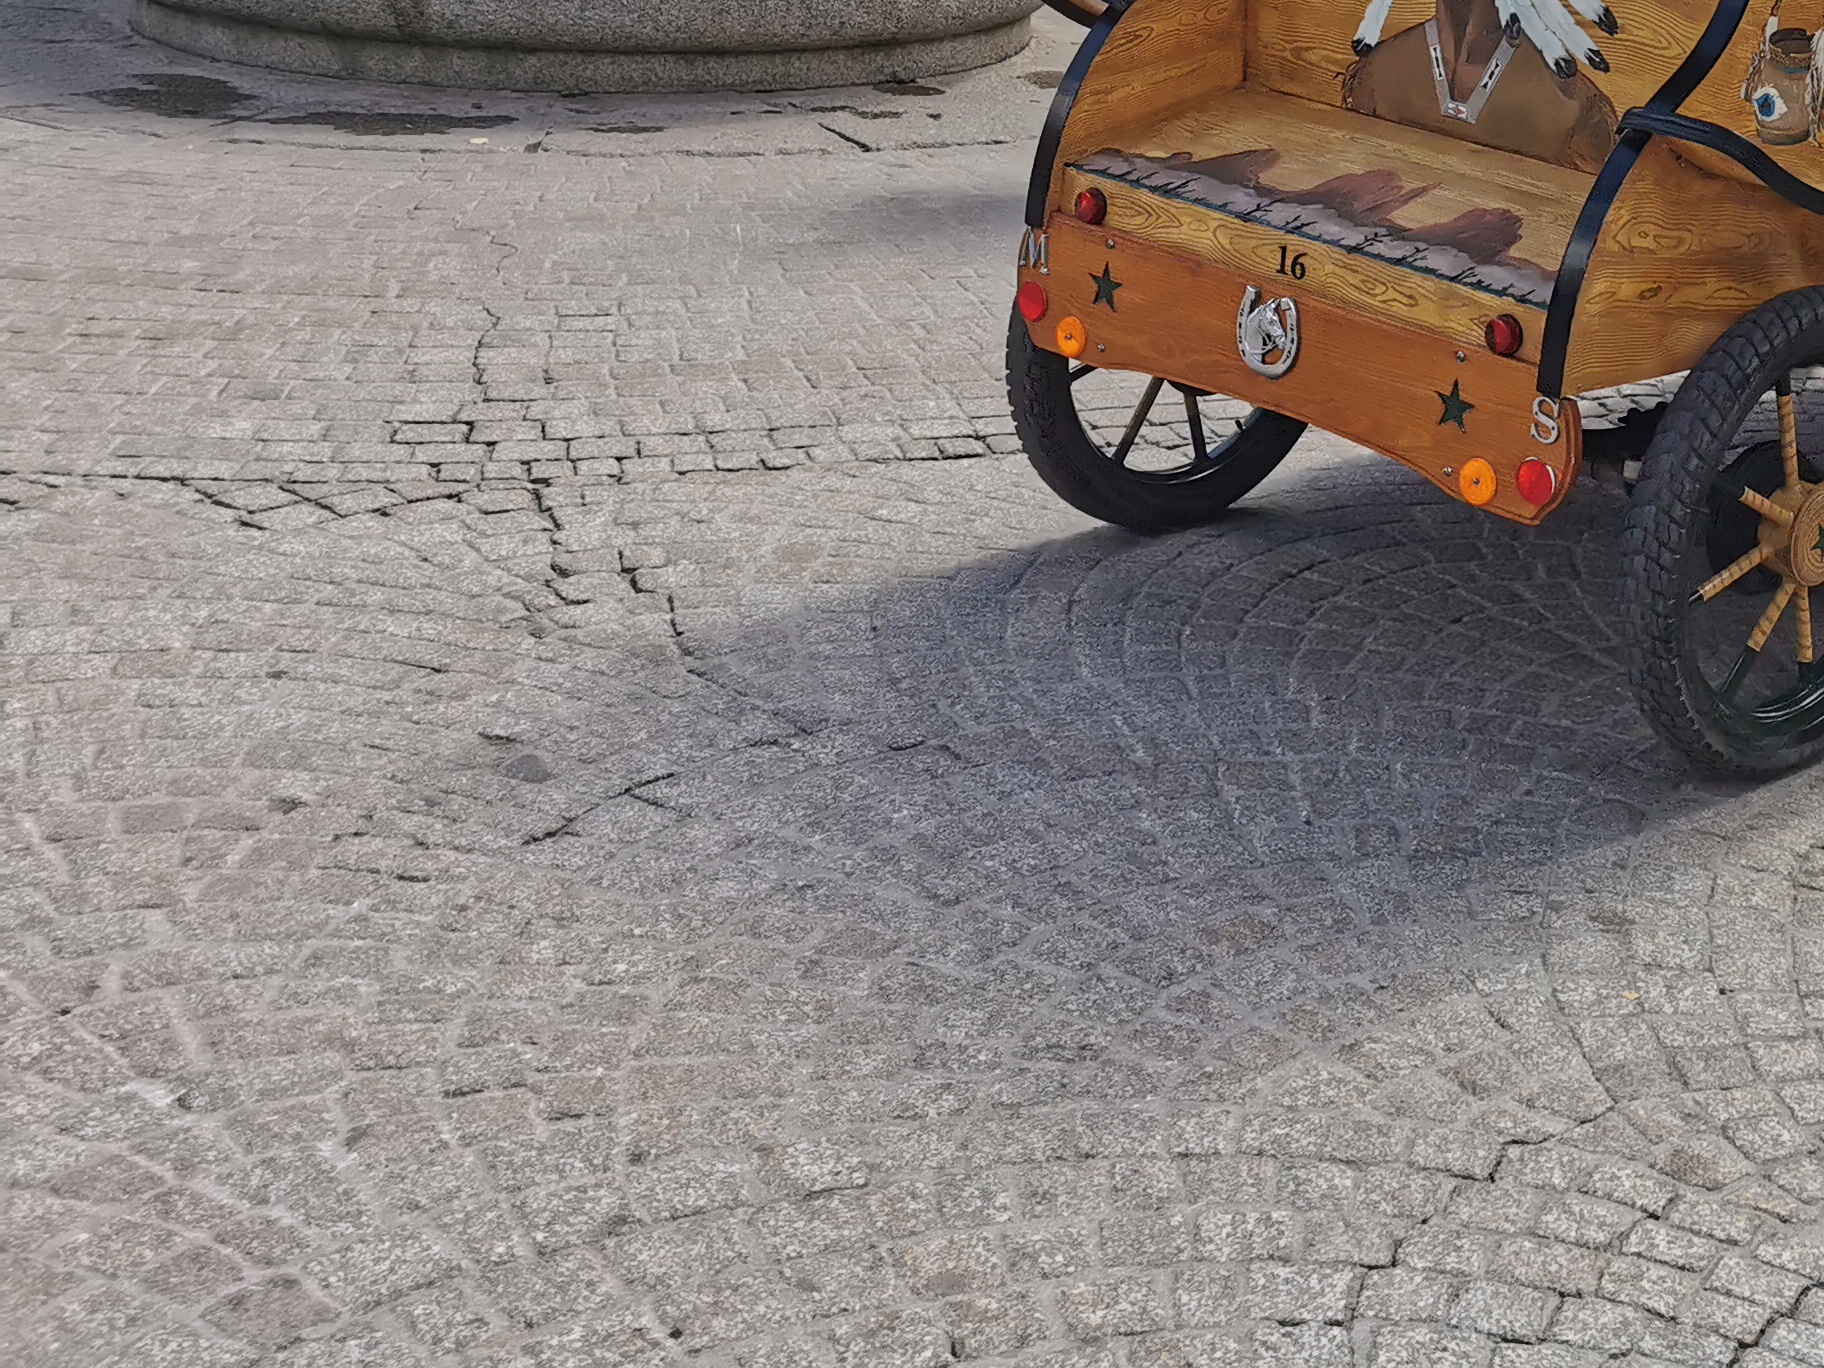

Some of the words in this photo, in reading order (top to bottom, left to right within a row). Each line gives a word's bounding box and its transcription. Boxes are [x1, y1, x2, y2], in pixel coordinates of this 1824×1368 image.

[1020, 227, 1050, 274] M
[1275, 244, 1309, 281] 16
[1529, 394, 1561, 445] S
